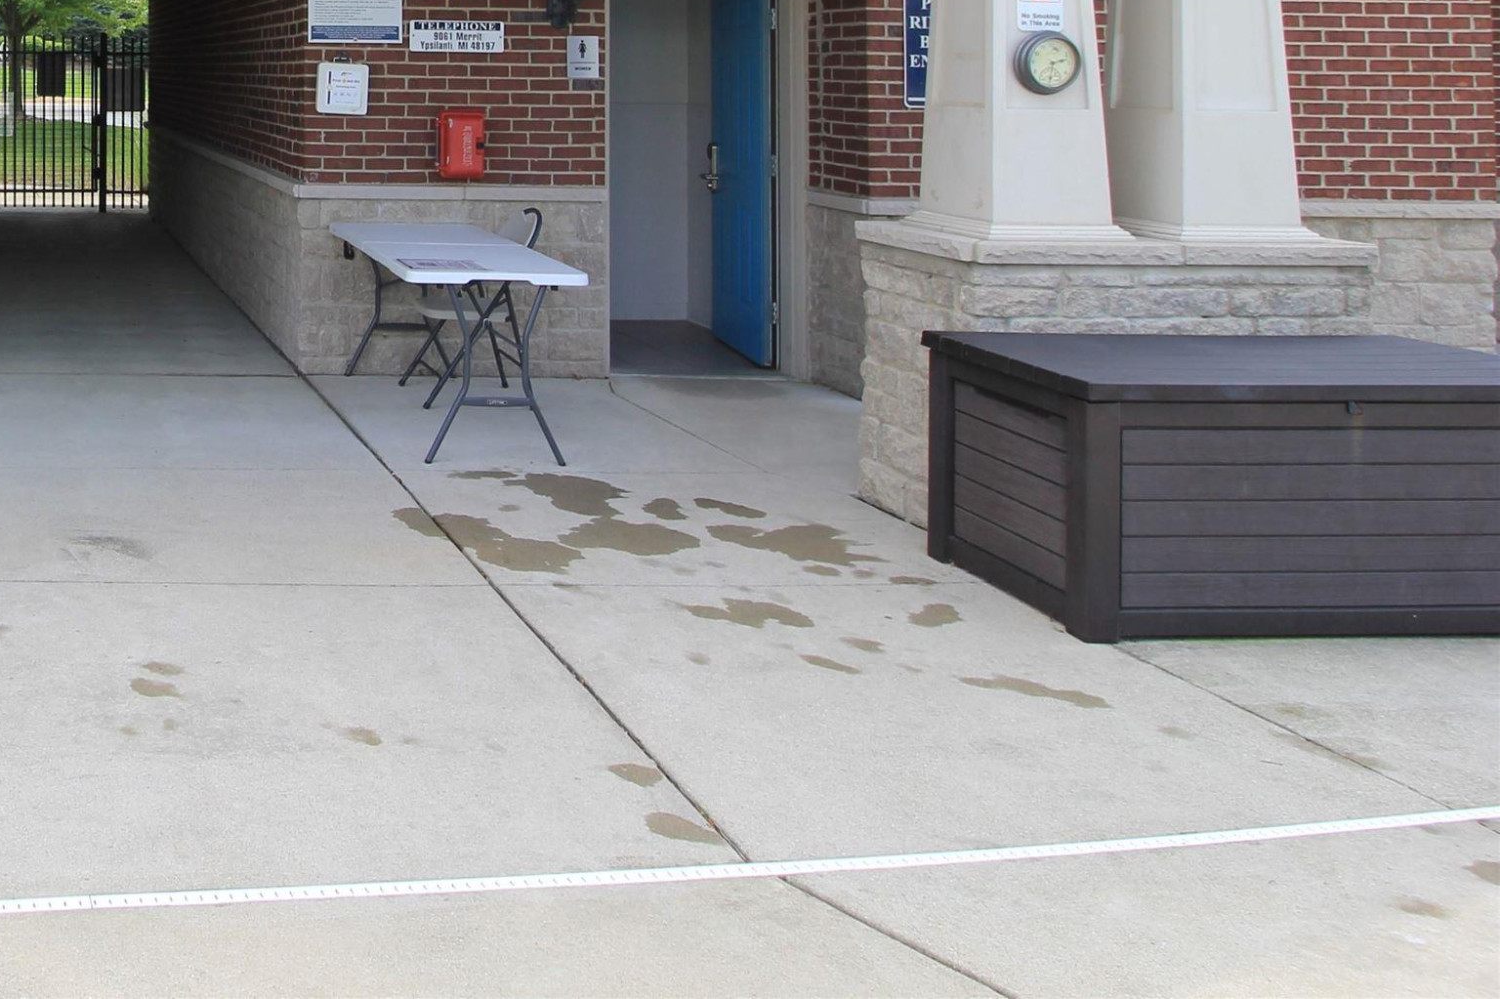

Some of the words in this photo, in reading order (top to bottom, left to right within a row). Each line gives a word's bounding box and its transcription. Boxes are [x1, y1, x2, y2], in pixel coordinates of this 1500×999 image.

[418, 22, 497, 30] TELEPHONE
[458, 42, 469, 50] MI
[471, 42, 496, 50] 48197
